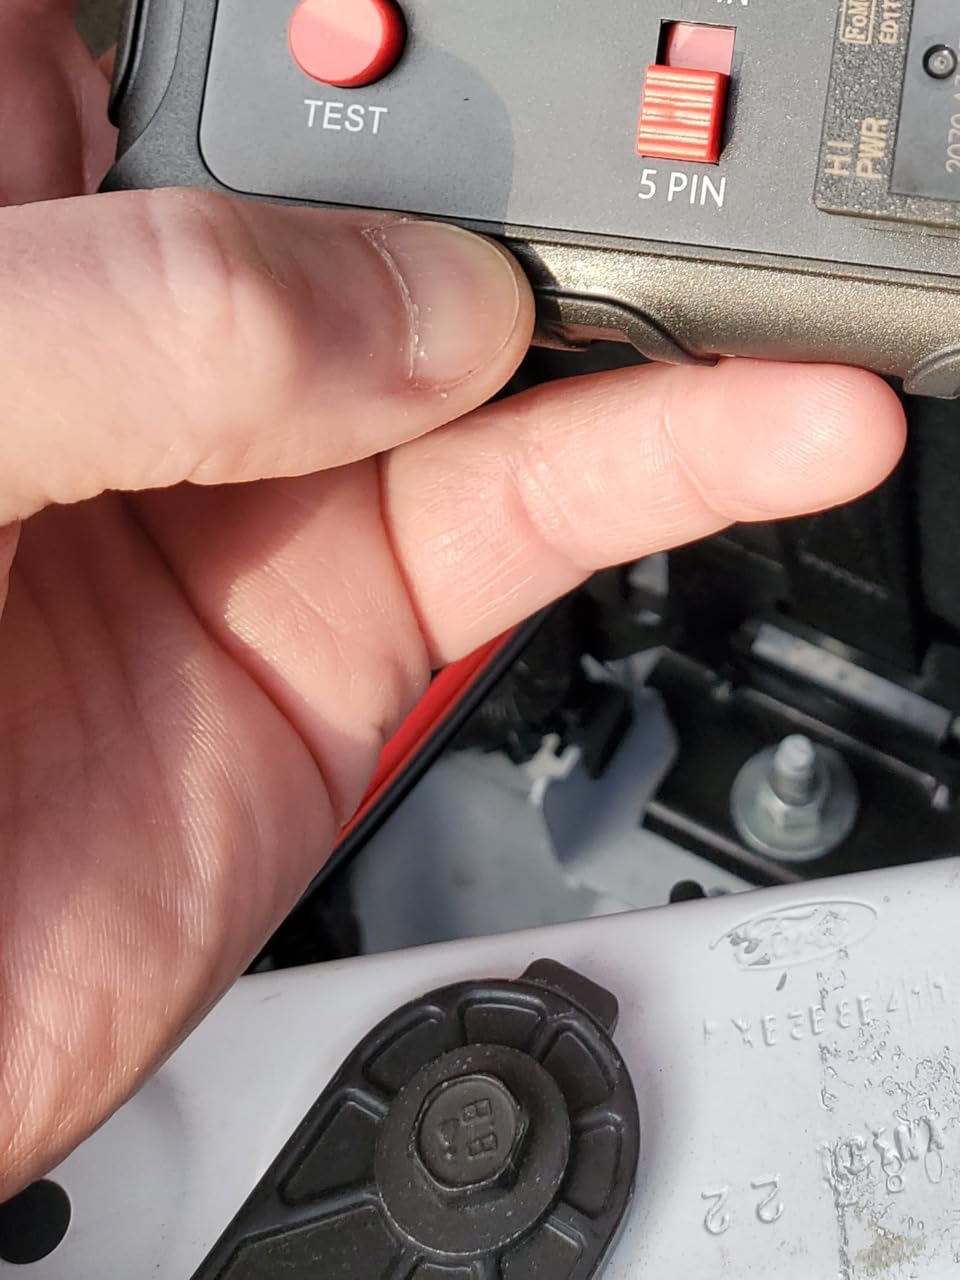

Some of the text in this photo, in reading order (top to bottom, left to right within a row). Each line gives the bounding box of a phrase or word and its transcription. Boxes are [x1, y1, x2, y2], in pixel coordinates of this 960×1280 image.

[303, 99, 389, 135] TEST
[855, 115, 890, 181] PWR
[637, 168, 727, 208] 5 PIN
